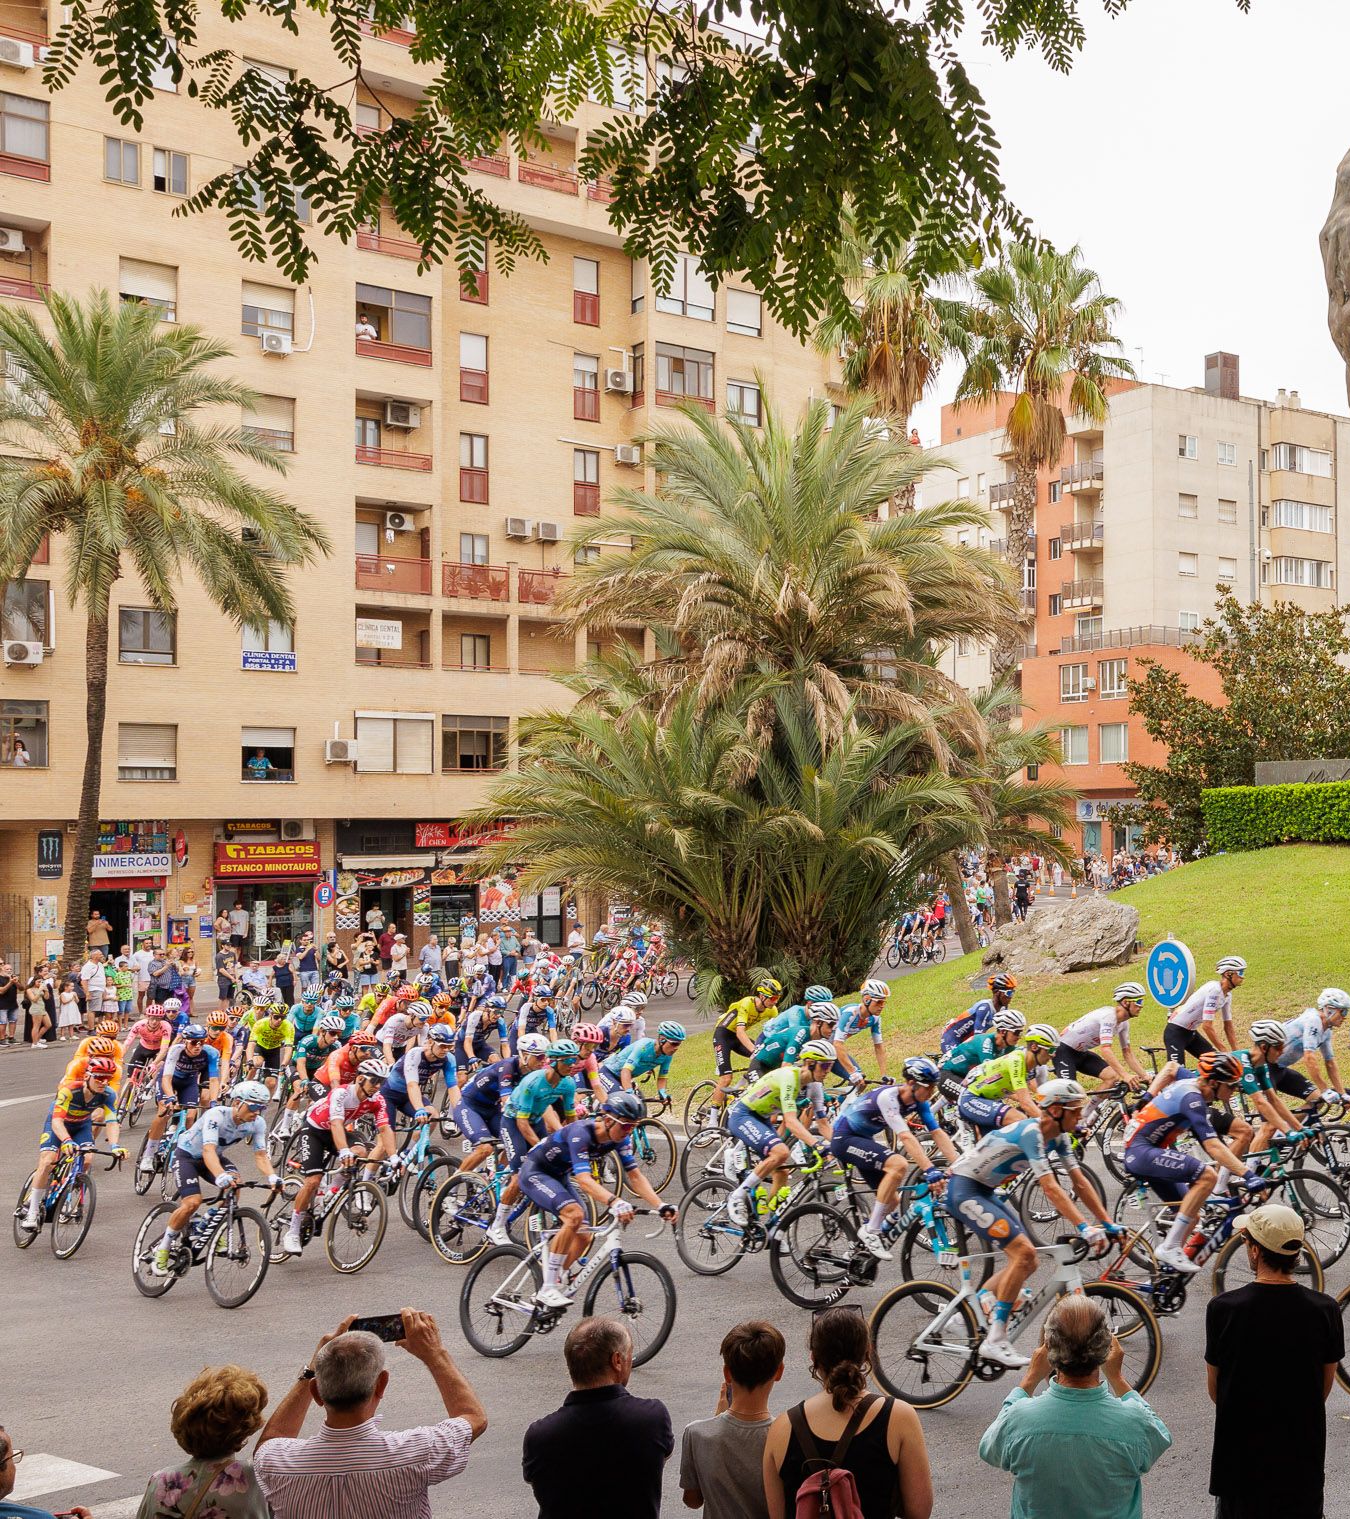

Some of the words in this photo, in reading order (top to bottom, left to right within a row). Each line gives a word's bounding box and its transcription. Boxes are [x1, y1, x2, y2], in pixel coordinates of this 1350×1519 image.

[271, 652, 296, 660] DENTAL
[428, 838, 447, 846] CHEN
[247, 845, 315, 855] TABACOS
[94, 855, 169, 868] INIMERCADO
[220, 863, 263, 873] ESTANCO
[264, 862, 318, 872] MINOTAURO
[953, 1019, 975, 1038] Jayco
[461, 1108, 474, 1135] Groupama
[1152, 1156, 1186, 1171] ALULA
[528, 1175, 557, 1199] Groupama
[194, 1206, 228, 1249] CANYON
[882, 1205, 918, 1250] ACTOR
